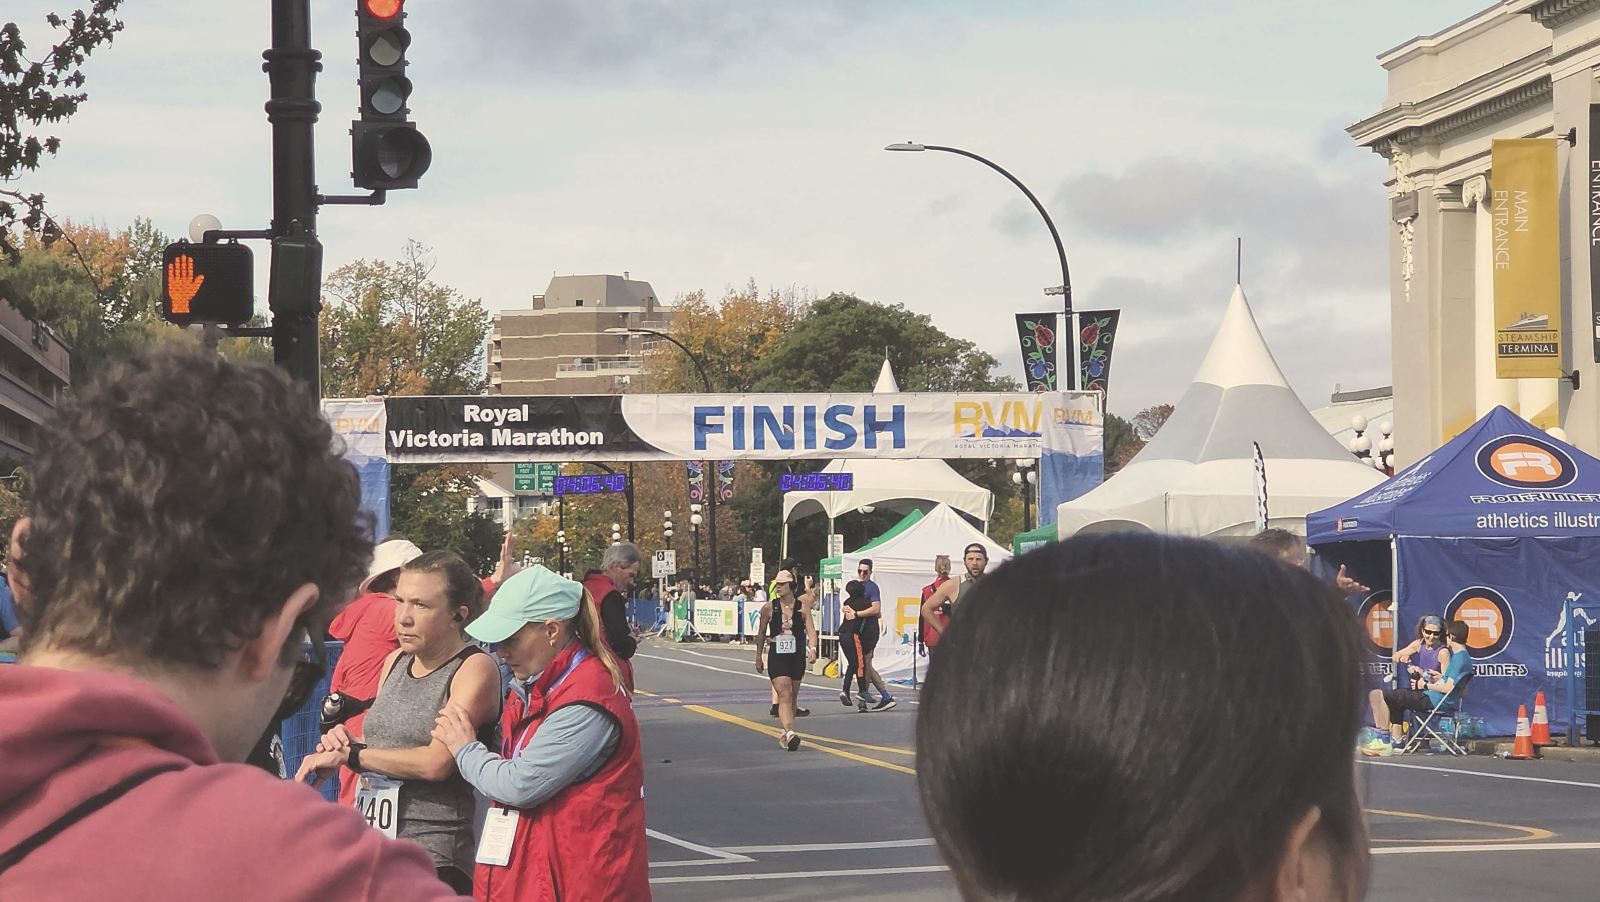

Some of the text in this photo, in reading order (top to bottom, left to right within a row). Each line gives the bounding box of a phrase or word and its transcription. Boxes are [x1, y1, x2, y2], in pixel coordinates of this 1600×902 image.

[1514, 190, 1528, 232] MAIN
[1494, 190, 1510, 270] ENTRANCE
[1498, 332, 1558, 343] STEAMSHIP
[1502, 344, 1555, 354] TERMINAL
[463, 404, 529, 423] Royal
[954, 401, 1043, 438] RVM
[1054, 407, 1092, 424] RVM
[336, 418, 380, 434] RVM
[694, 405, 906, 450] FINISH
[389, 428, 604, 448] Victoria Marathon
[1497, 452, 1557, 476] FR
[1470, 493, 1600, 503] FRONTRUNNER
[1476, 512, 1600, 528] athletics illustr
[700, 617, 717, 626] FOODS
[779, 641, 793, 650] 927
[1472, 664, 1528, 677] RUNNERS
[357, 796, 393, 830] 40
